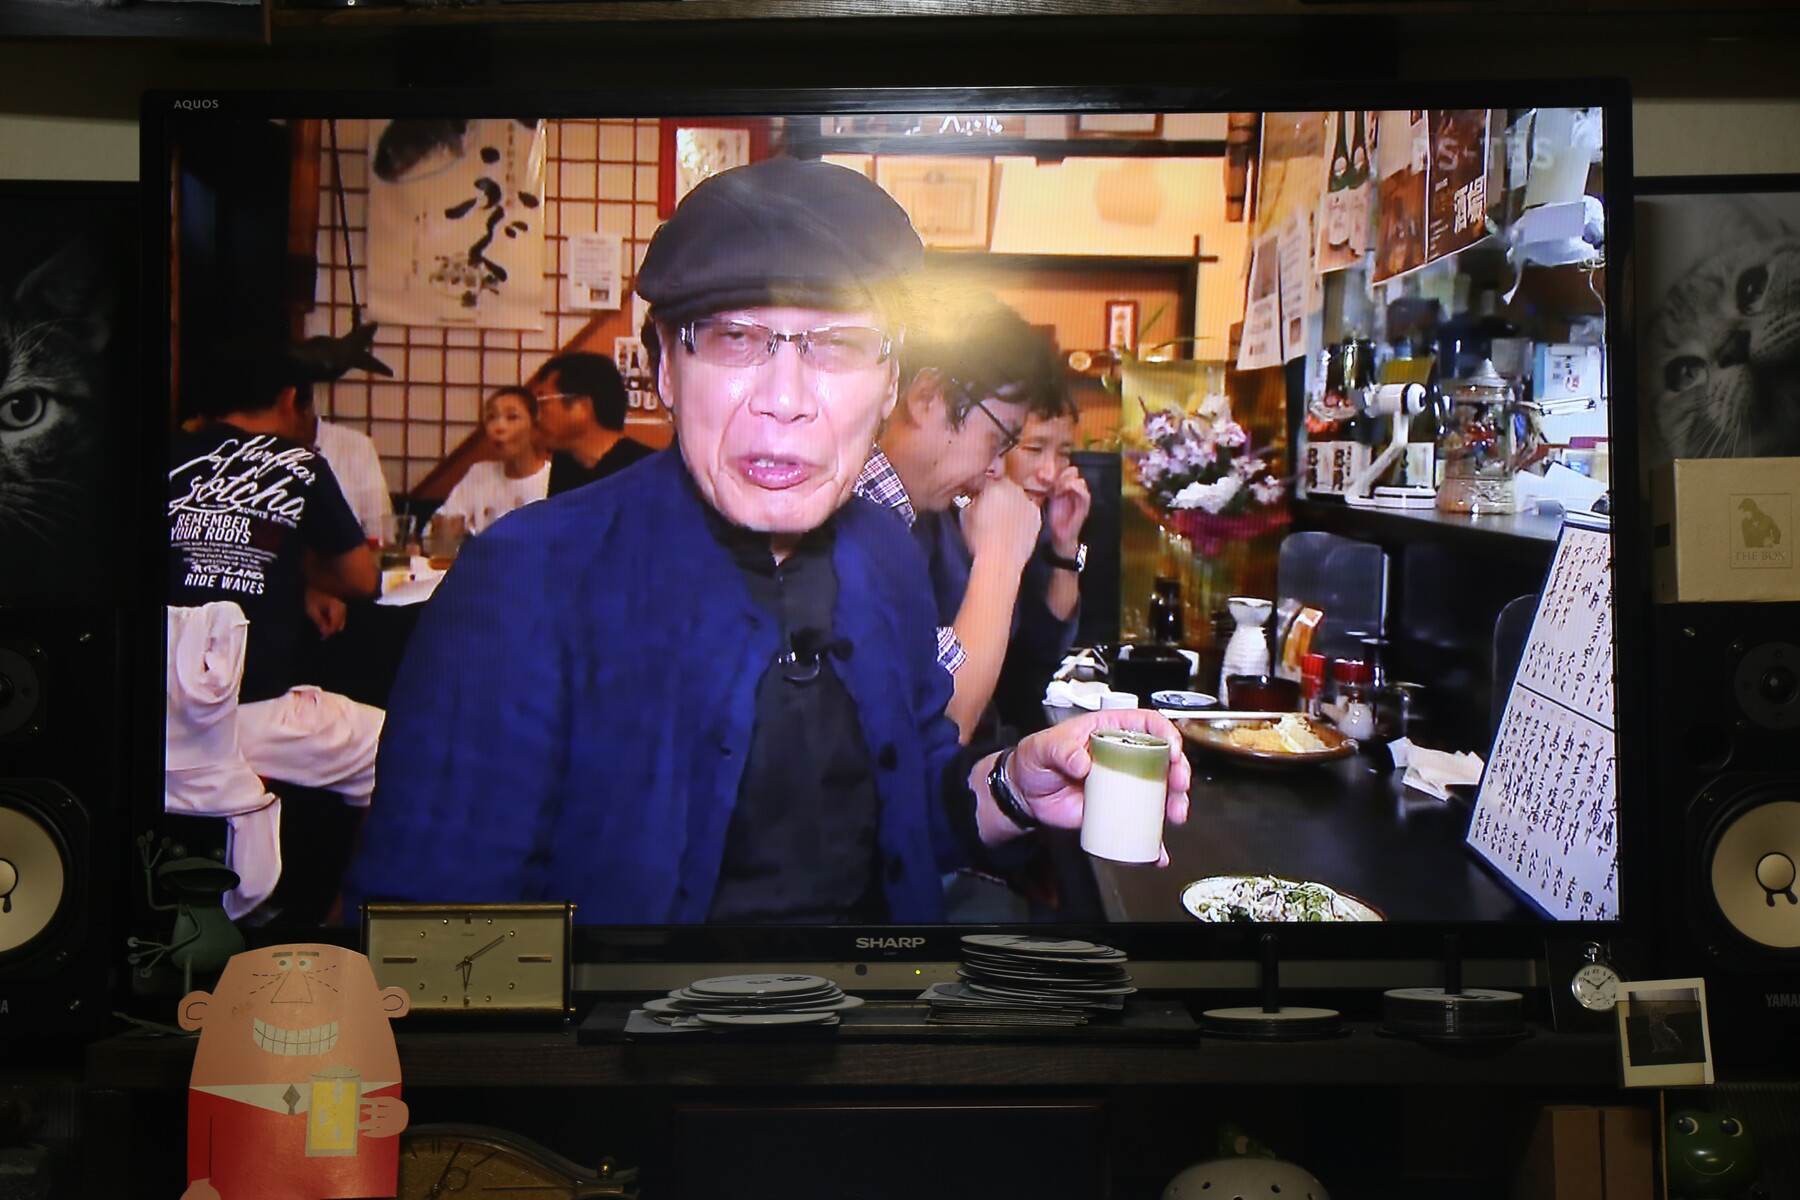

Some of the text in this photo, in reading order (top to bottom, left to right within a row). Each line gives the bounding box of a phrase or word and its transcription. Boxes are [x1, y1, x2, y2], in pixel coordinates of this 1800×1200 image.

[173, 99, 219, 110] AQUOS
[177, 511, 251, 531] REMEMBER
[170, 526, 252, 545] YOUR ROOTS
[1735, 550, 1786, 561] THE BOX
[184, 572, 217, 588] RIDE
[221, 574, 265, 595] WAVES
[855, 936, 926, 949] SHARP
[1765, 993, 1800, 1008] YAMA
